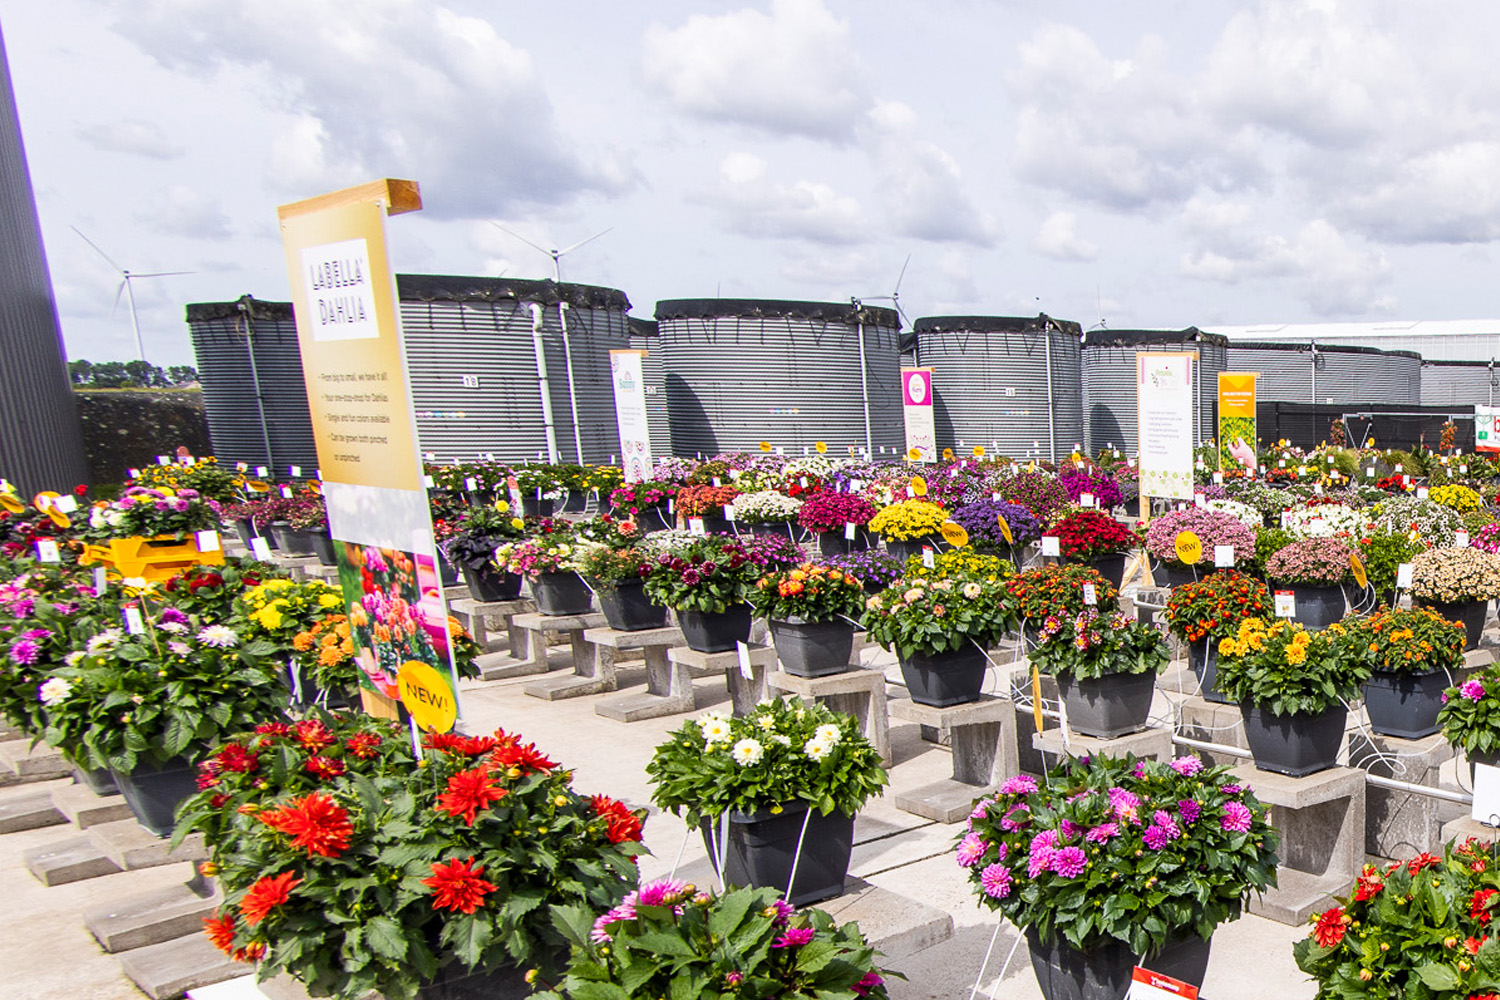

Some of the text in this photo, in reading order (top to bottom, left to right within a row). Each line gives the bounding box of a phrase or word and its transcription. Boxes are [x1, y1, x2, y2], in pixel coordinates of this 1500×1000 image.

[318, 297, 368, 326] DAHLIA
[1178, 542, 1198, 553] NEW!
[406, 682, 449, 713] NEW!
